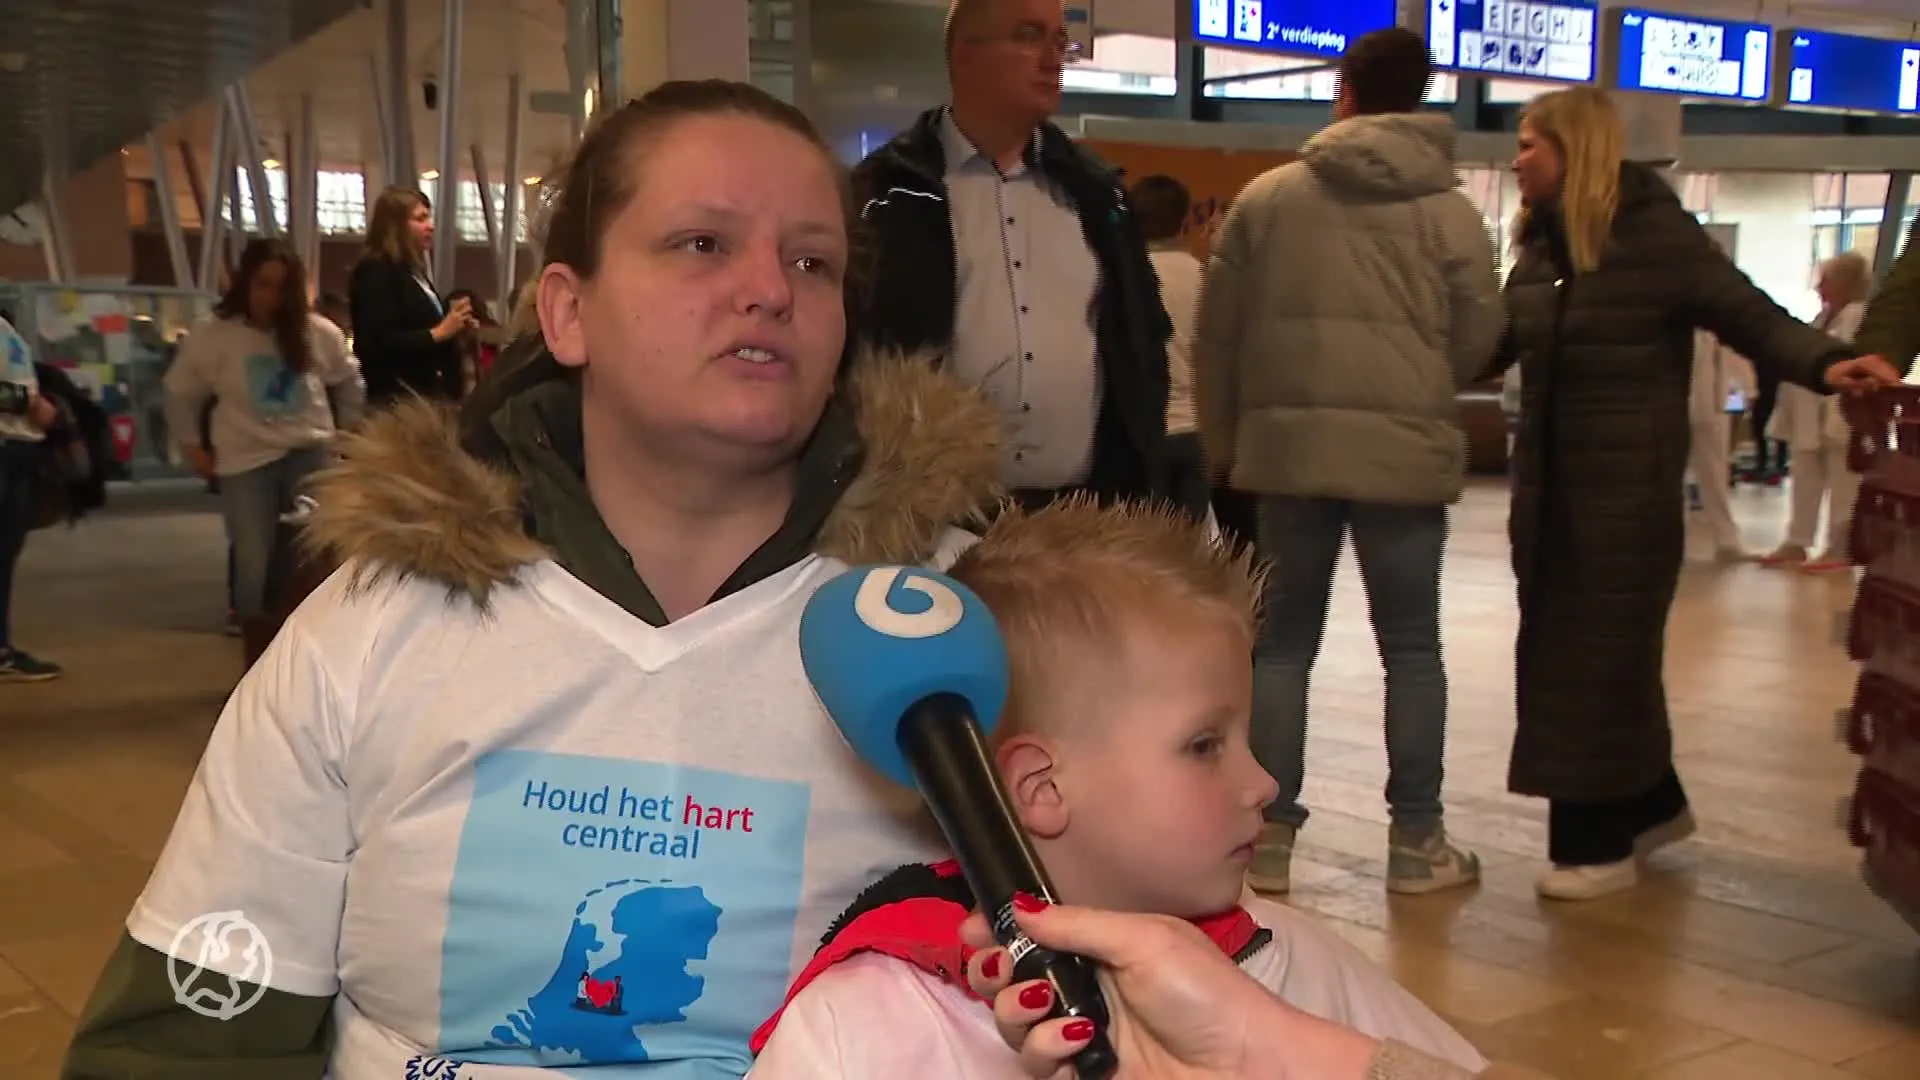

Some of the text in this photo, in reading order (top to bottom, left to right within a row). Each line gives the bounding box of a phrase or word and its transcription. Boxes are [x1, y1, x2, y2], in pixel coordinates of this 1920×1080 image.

[1489, 4, 1500, 29] E
[1511, 8, 1521, 31] F
[1531, 11, 1545, 35] G
[1281, 27, 1346, 52] verdieping
[523, 780, 755, 832] Houd het hart
[562, 822, 700, 860] centraal
